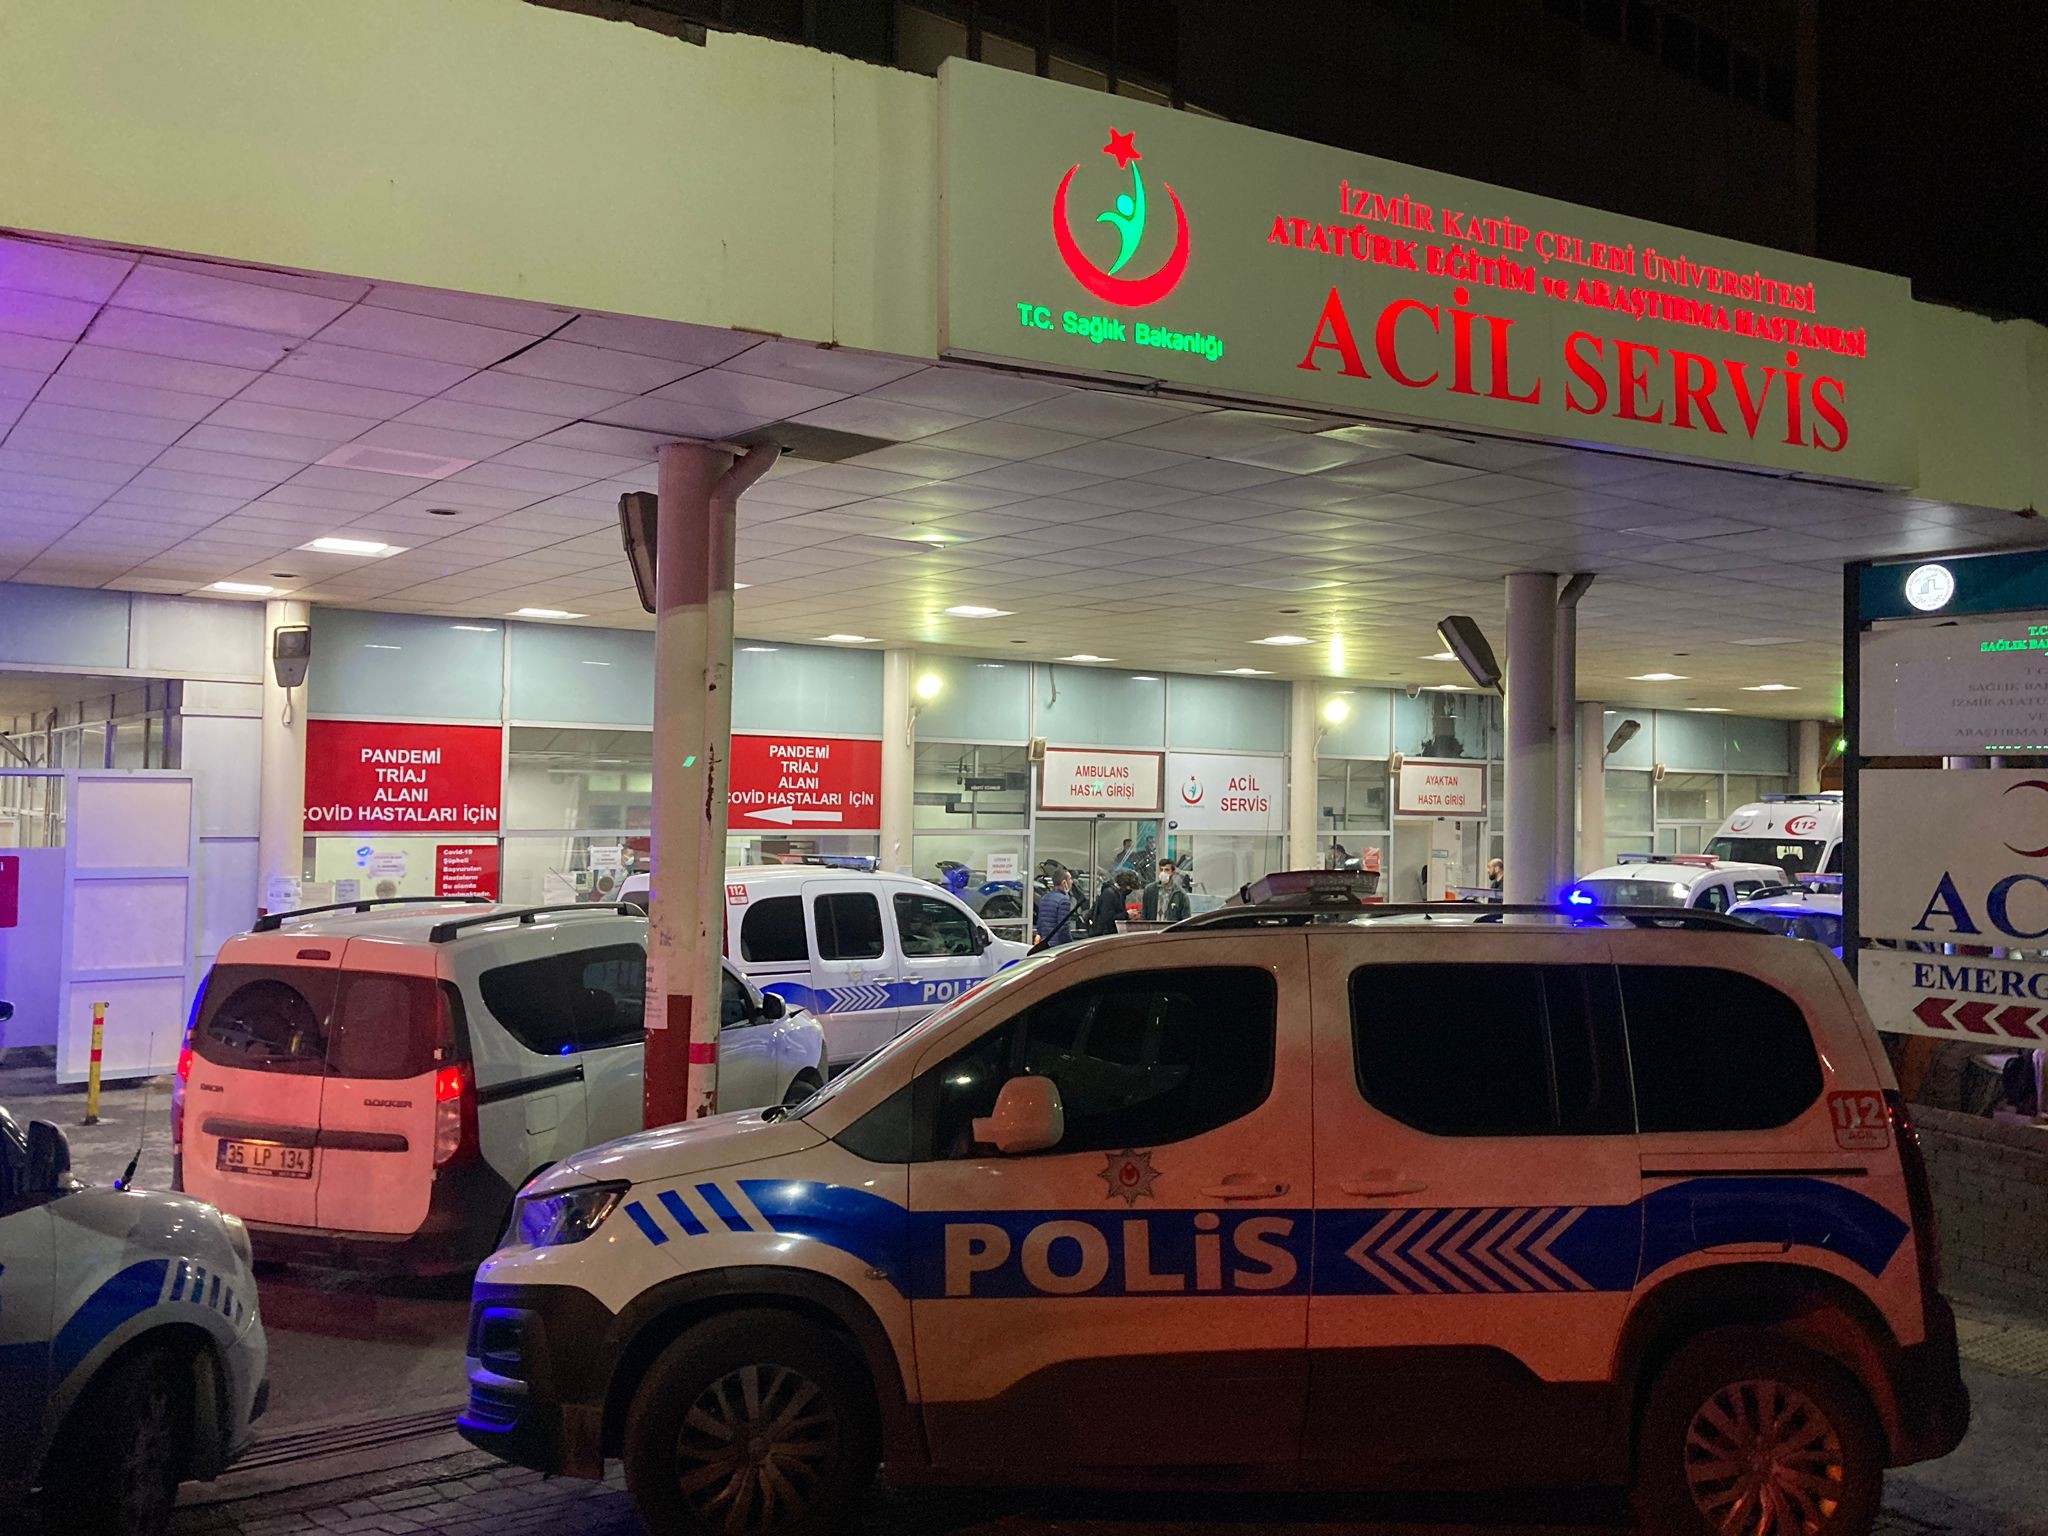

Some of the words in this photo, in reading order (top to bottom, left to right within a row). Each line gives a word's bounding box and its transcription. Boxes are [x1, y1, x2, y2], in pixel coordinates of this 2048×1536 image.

[1339, 179, 1435, 233] İZMİR
[1442, 204, 1531, 252] KATİP
[1534, 229, 1636, 277] ÇELEBİ
[1642, 247, 1816, 314] ÜNİVERSİTESİ
[1267, 214, 1420, 273] ATATÜRK
[1425, 243, 1537, 296] EĞİTİM
[1541, 276, 1571, 302] ve
[1573, 277, 1733, 334] ARAŞTIRMA
[1734, 307, 1868, 359] HASTANESİ
[1016, 301, 1055, 331] T.C.
[1062, 309, 1127, 345] Sağlık
[1134, 321, 1225, 363] Bakanlığı
[1297, 285, 1542, 406] ACİL
[1563, 330, 1849, 453] SERVİS
[1981, 640, 2027, 652] SAĞLIK
[361, 747, 441, 765] PANDEMİ
[769, 744, 830, 760] PANDEMİ
[780, 759, 819, 774] TRİAJ
[1075, 765, 1129, 779] AMBULANS
[376, 767, 426, 784] TRİAJ
[778, 777, 819, 790] ALANI
[1228, 774, 1259, 792] ACİL
[1425, 775, 1459, 787] AYAKTAN
[373, 787, 429, 803] ALANI
[767, 792, 842, 806] HASTALARI
[849, 790, 874, 808] İÇİN
[1070, 784, 1102, 797] HASTA
[1106, 783, 1135, 800] GİRİŞİ
[1418, 794, 1442, 806] HASTA
[1444, 793, 1466, 807] GİRİŞİ
[1220, 795, 1268, 812] SERVİS
[358, 806, 458, 823] HASTALARI
[463, 804, 497, 824] İÇİN
[1794, 821, 1817, 830] 112
[728, 885, 745, 896] 112
[1832, 1096, 1883, 1126] 112
[228, 1144, 244, 1164] 35
[253, 1148, 271, 1167] LP
[280, 1150, 304, 1170] 134
